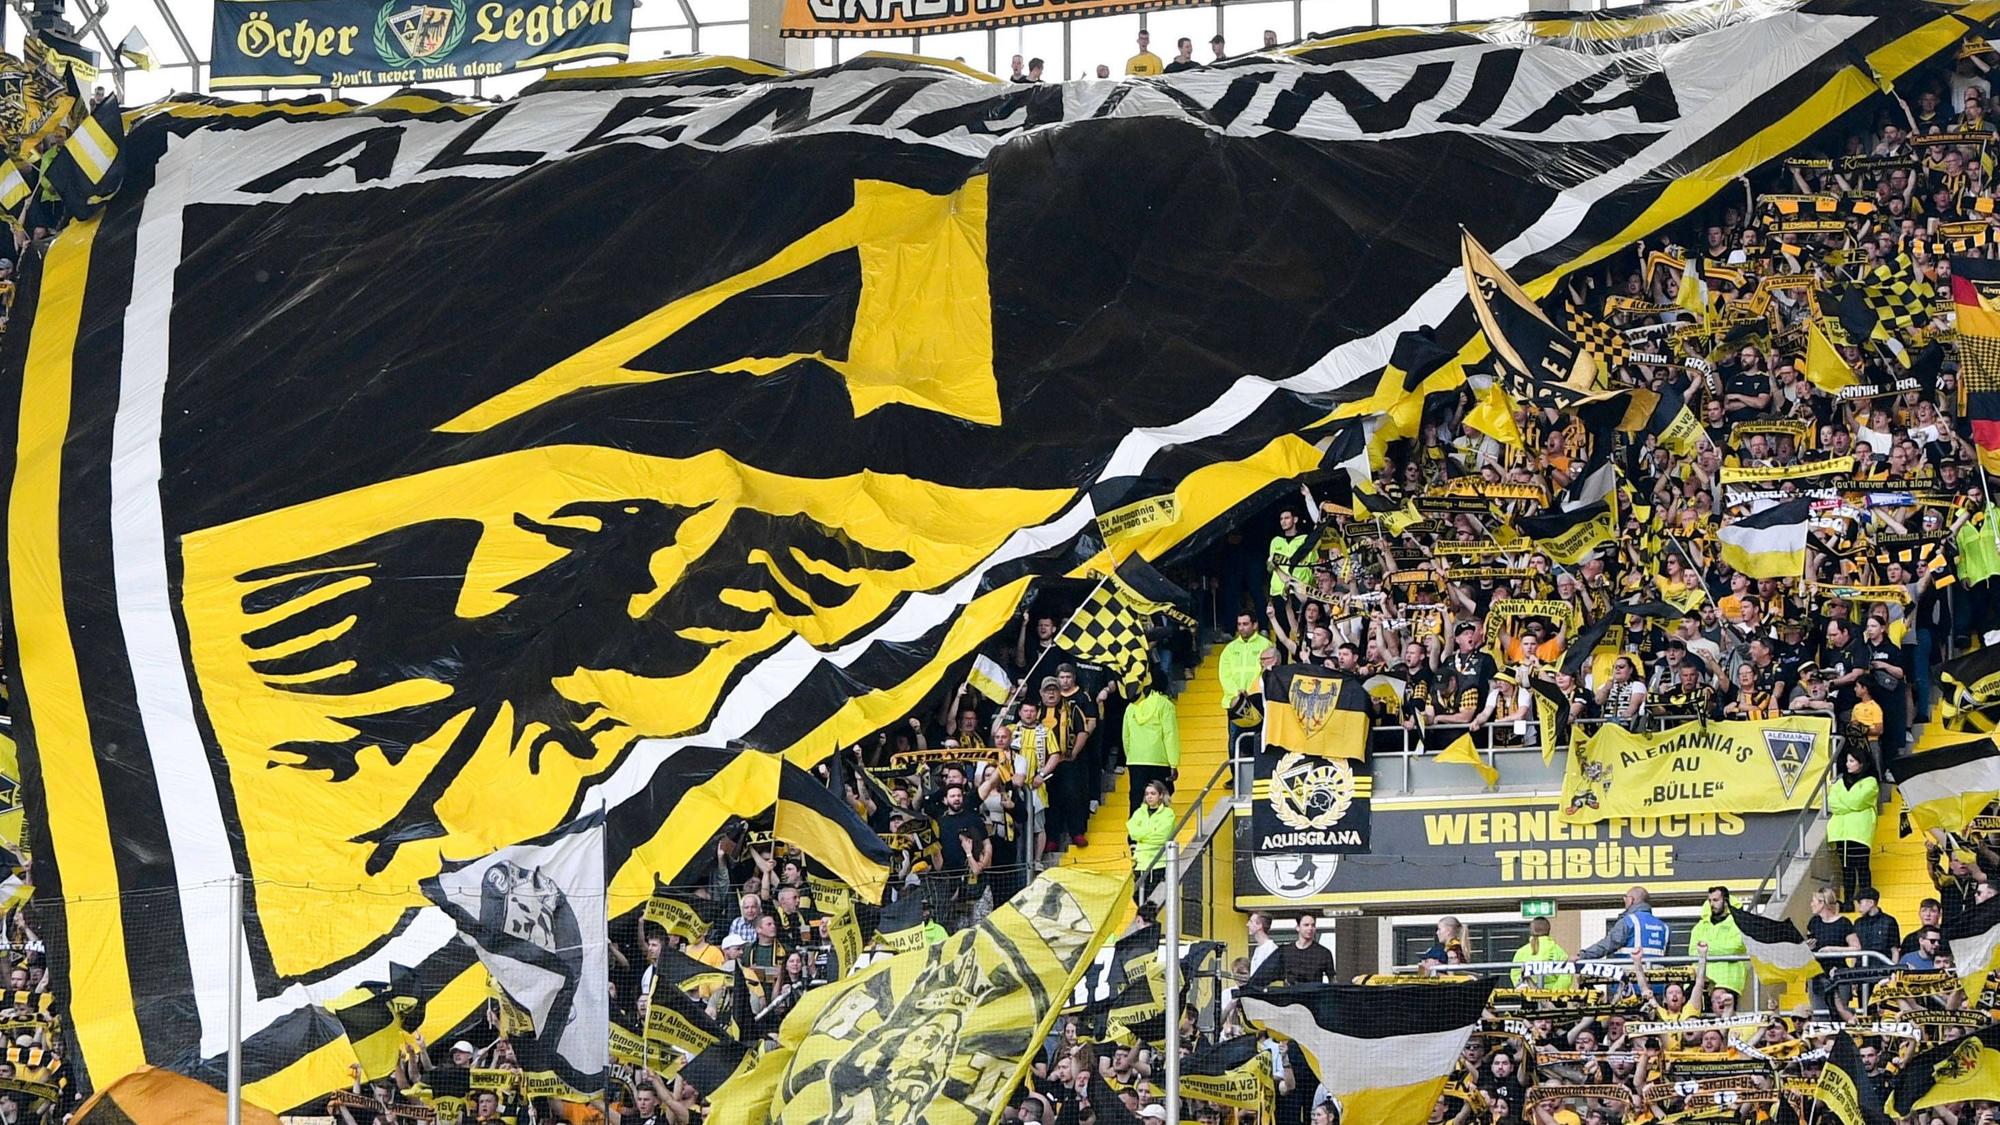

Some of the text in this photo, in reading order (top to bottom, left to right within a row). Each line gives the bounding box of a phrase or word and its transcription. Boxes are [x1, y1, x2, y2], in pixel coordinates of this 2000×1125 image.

[237, 0, 613, 65] Öcher Legion
[378, 70, 416, 84] never
[422, 64, 457, 80] walk
[463, 62, 503, 76] alone
[1859, 481, 1885, 489] never
[1888, 480, 1907, 489] walk
[1910, 479, 1932, 488] alone
[1111, 504, 1155, 526] Alemannia
[1672, 756, 1700, 772] AU
[1424, 810, 1746, 846] WERNER FUCHS
[1261, 830, 1362, 851] AQUISGRANA
[1495, 842, 1674, 882] TRIBÜNE
[667, 1013, 712, 1047] Alemanni
[1822, 1069, 1842, 1086] TSV
